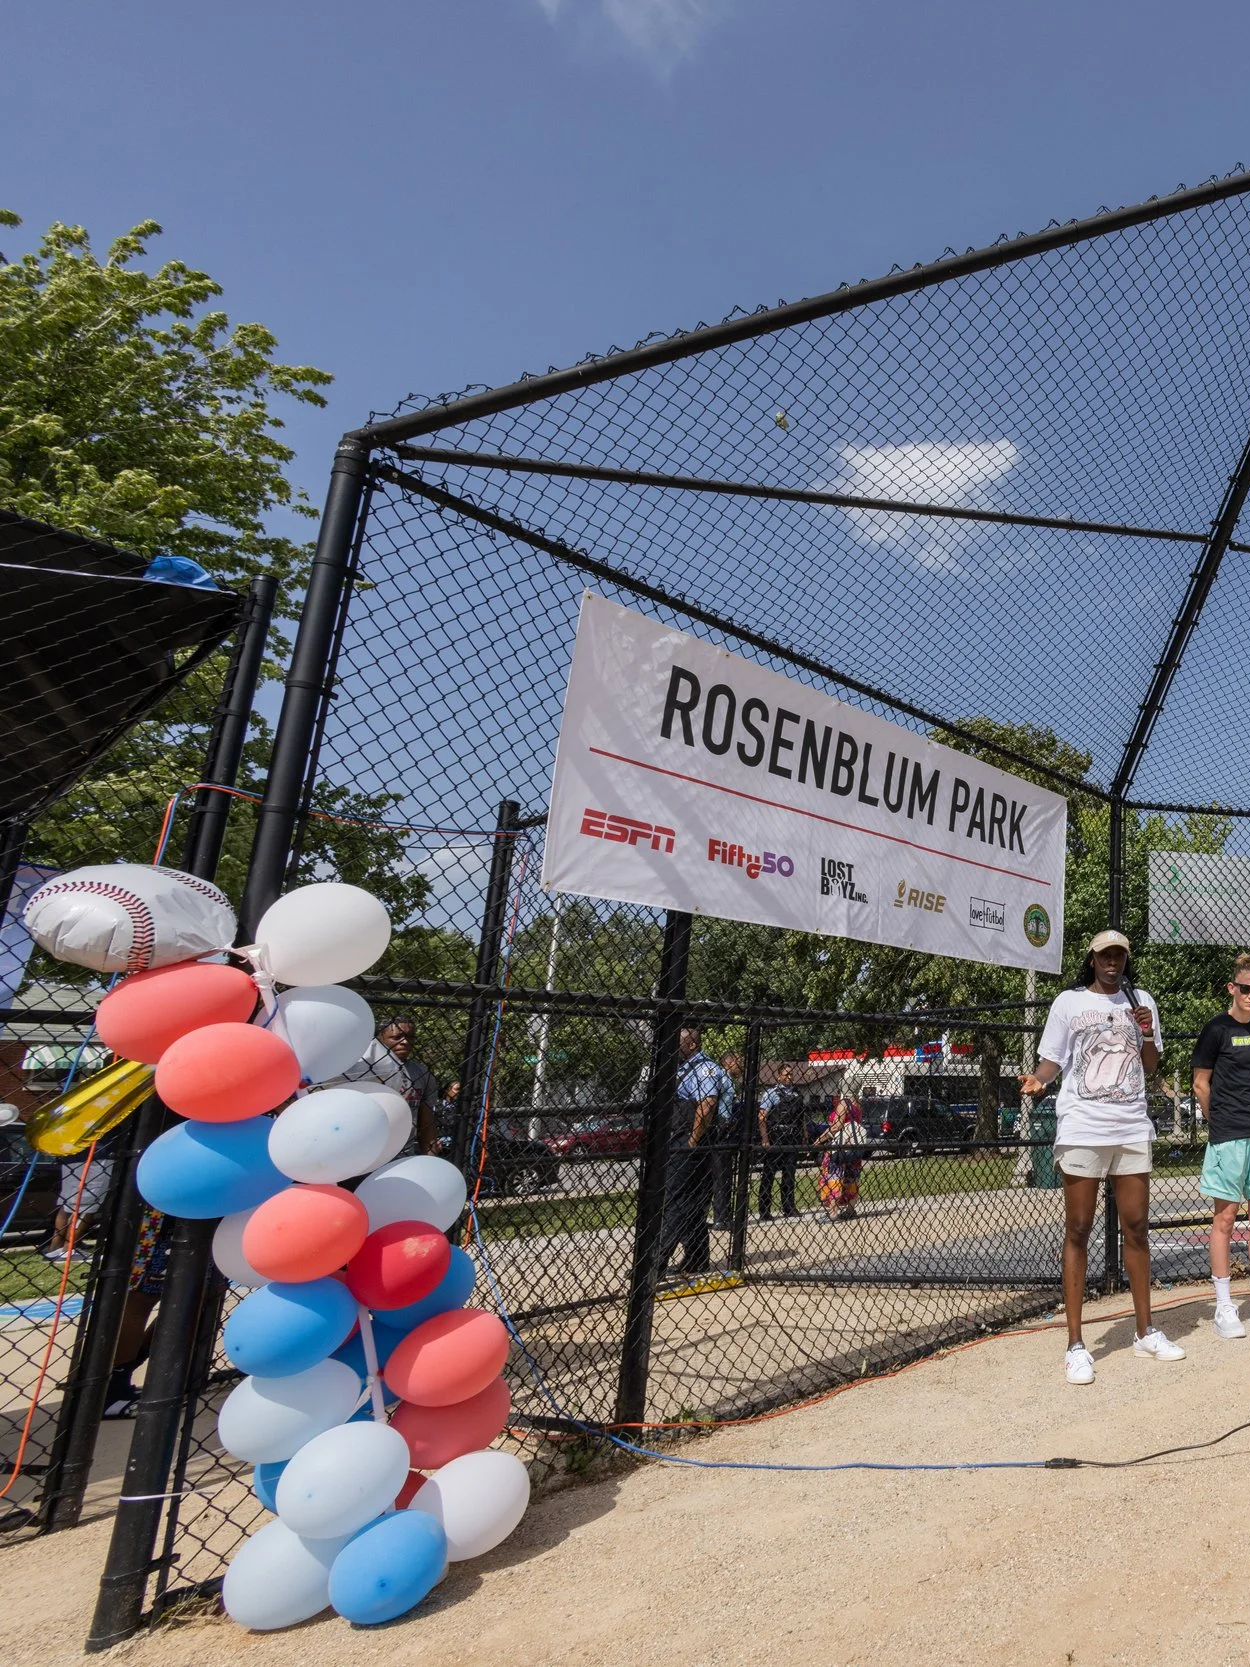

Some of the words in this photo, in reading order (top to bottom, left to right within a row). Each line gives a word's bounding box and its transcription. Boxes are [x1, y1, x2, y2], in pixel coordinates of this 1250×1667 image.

[660, 665, 941, 825] ROSENBLUM
[948, 778, 1028, 855] PARK
[580, 808, 676, 854] ESPN
[708, 838, 794, 879] Fifty50
[821, 857, 854, 881] LOST
[821, 876, 855, 900] BOYZ
[855, 892, 868, 904] INC.
[907, 888, 946, 914] RISE
